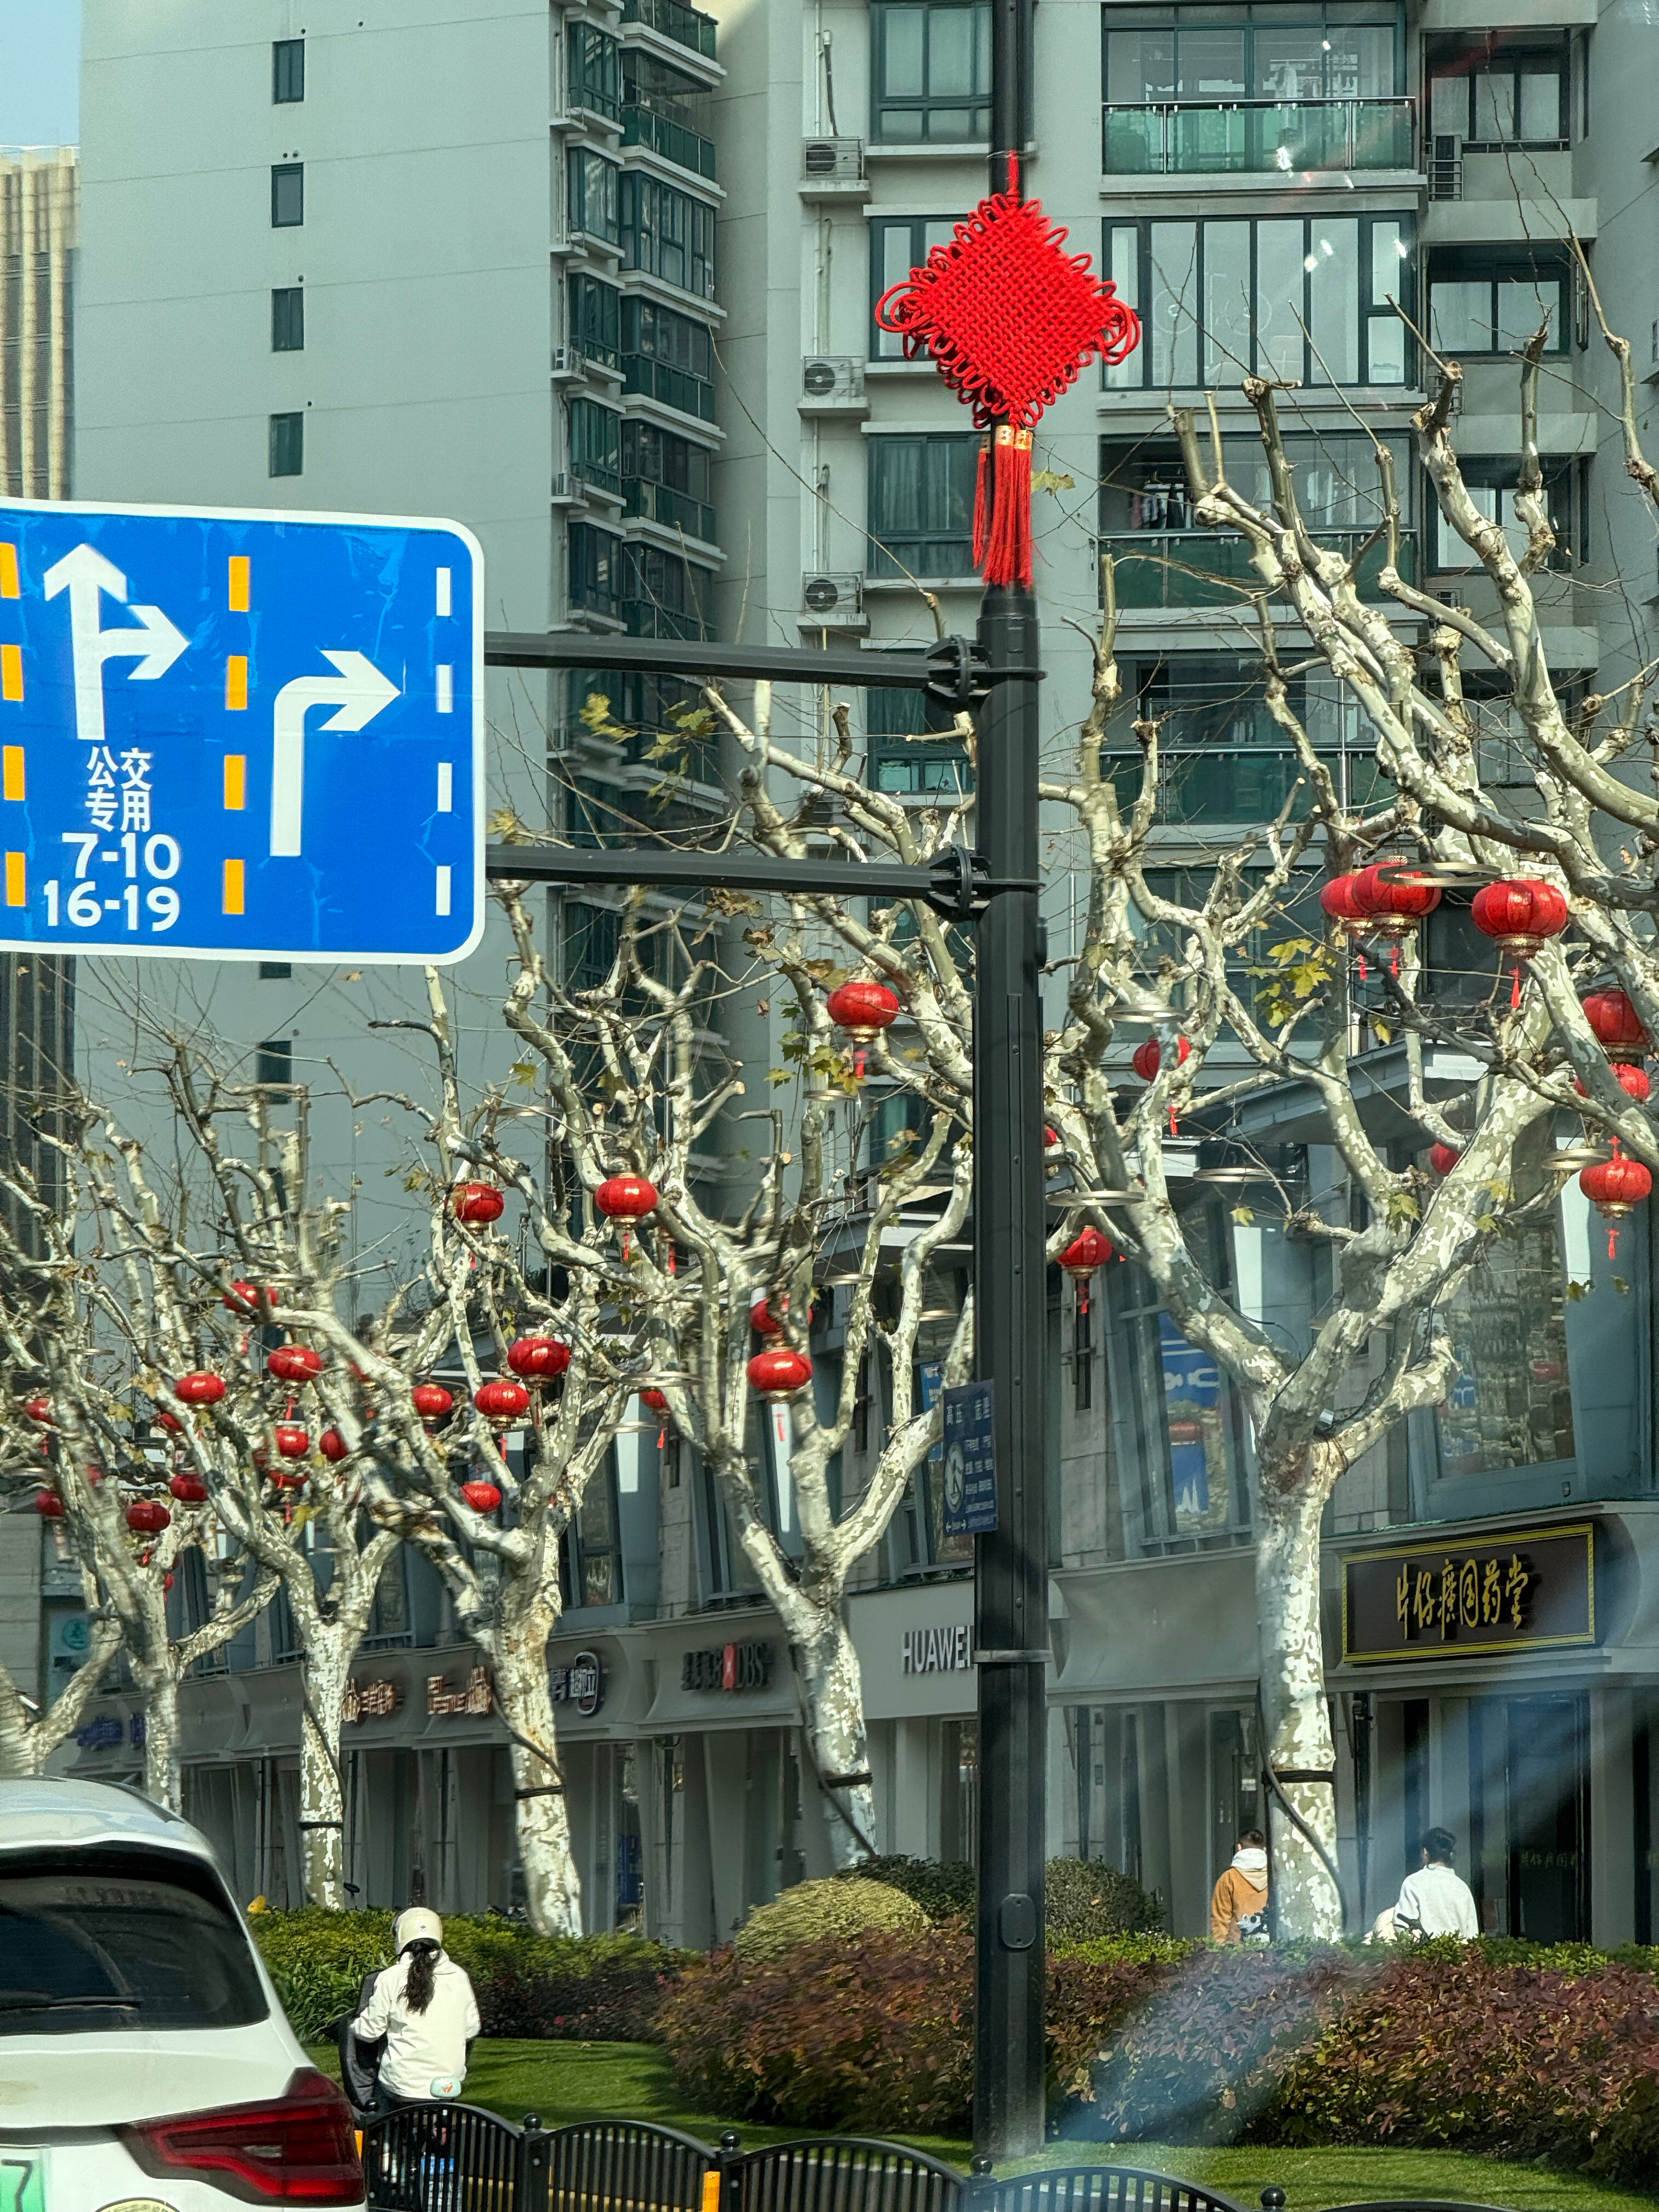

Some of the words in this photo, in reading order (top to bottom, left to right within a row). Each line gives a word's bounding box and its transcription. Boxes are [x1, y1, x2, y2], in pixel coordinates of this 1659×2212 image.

[86, 746, 153, 791] 公交
[85, 787, 151, 832] 专用
[61, 832, 180, 879] 7-10
[43, 880, 180, 932] 16-19
[901, 1625, 971, 1673] HUAWEI
